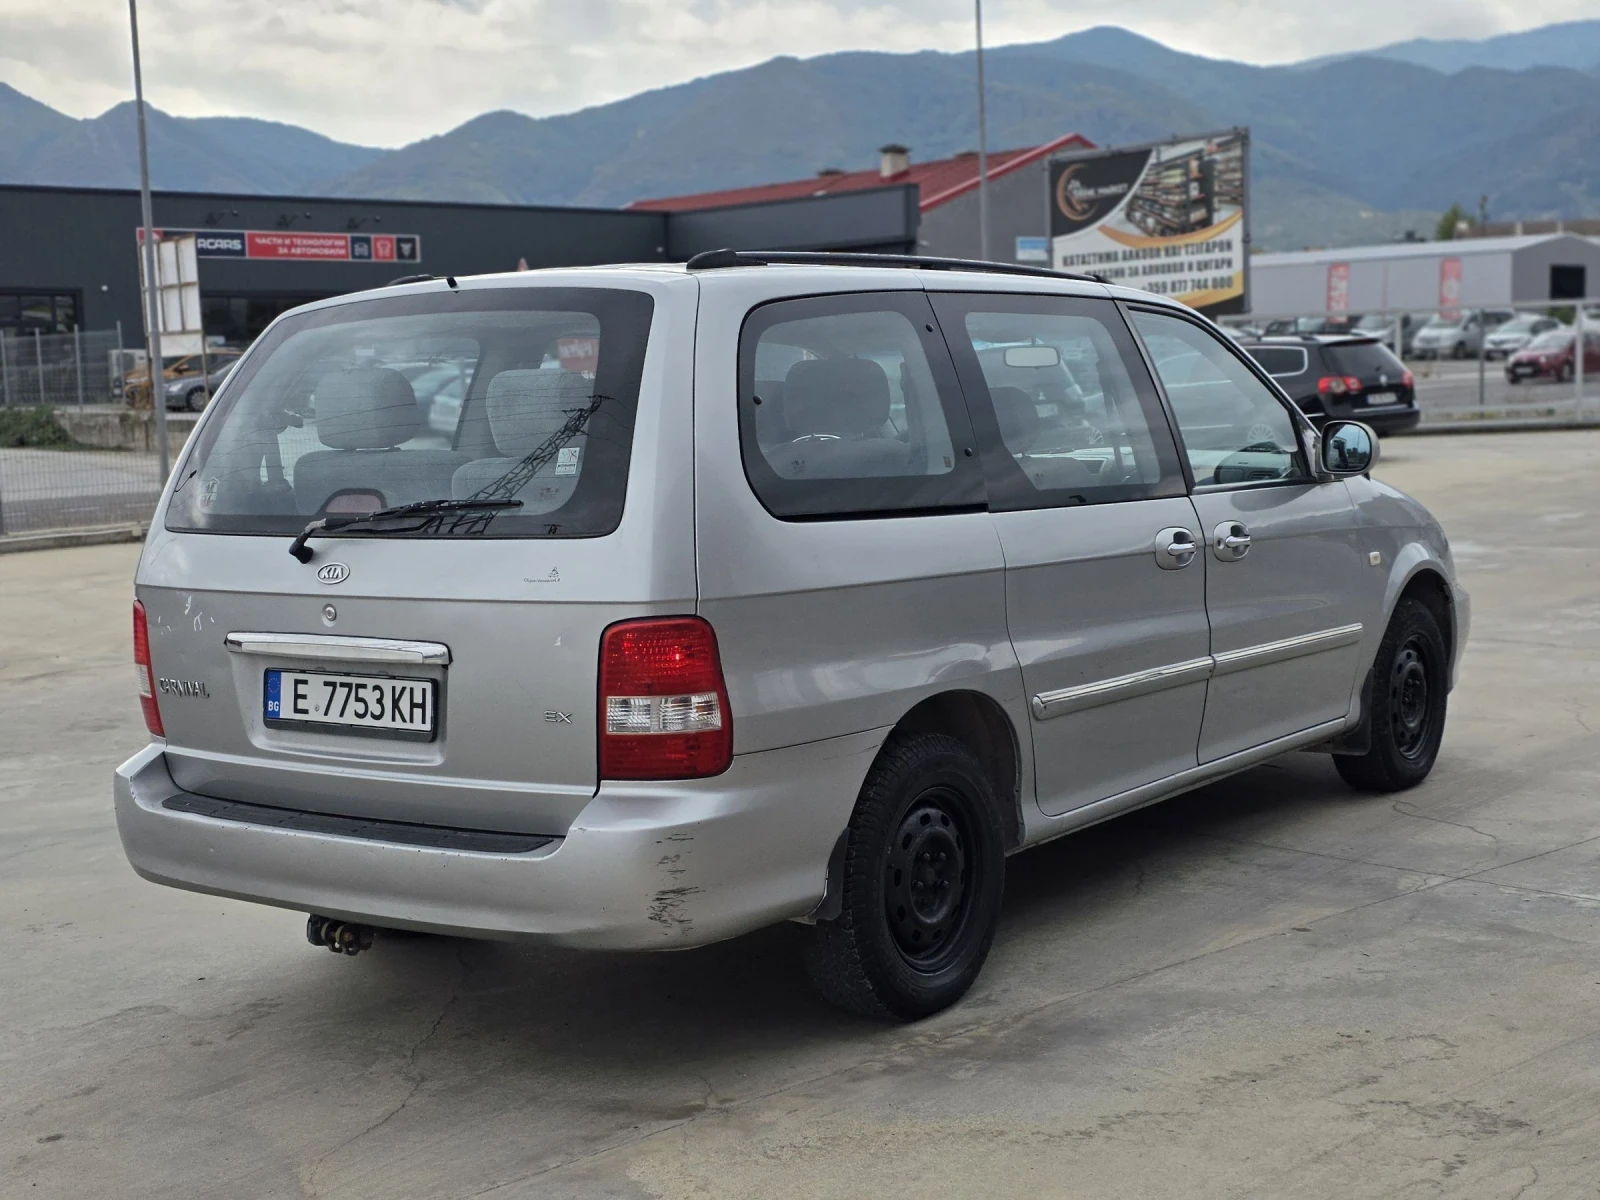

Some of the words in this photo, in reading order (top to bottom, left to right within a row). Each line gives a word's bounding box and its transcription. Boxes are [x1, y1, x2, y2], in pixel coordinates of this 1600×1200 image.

[255, 236, 282, 245] ЧАСТИ
[284, 237, 291, 245] И
[291, 237, 346, 247] ТЕХНОЛОГИИ
[290, 247, 346, 256] АВТОМОБИЛИ
[1127, 265, 1139, 277] ЗА
[1141, 261, 1185, 276] АЛКОХОЛ
[1187, 260, 1193, 271] И
[1195, 257, 1233, 272] ЦИГАРИ
[1170, 279, 1188, 292] 877
[320, 566, 344, 579] KIA
[158, 677, 209, 698] CARNIVAL
[268, 701, 279, 711] BG
[293, 678, 309, 715] E
[323, 680, 385, 721] 7753
[391, 685, 427, 725] KH
[543, 710, 573, 724] EX
